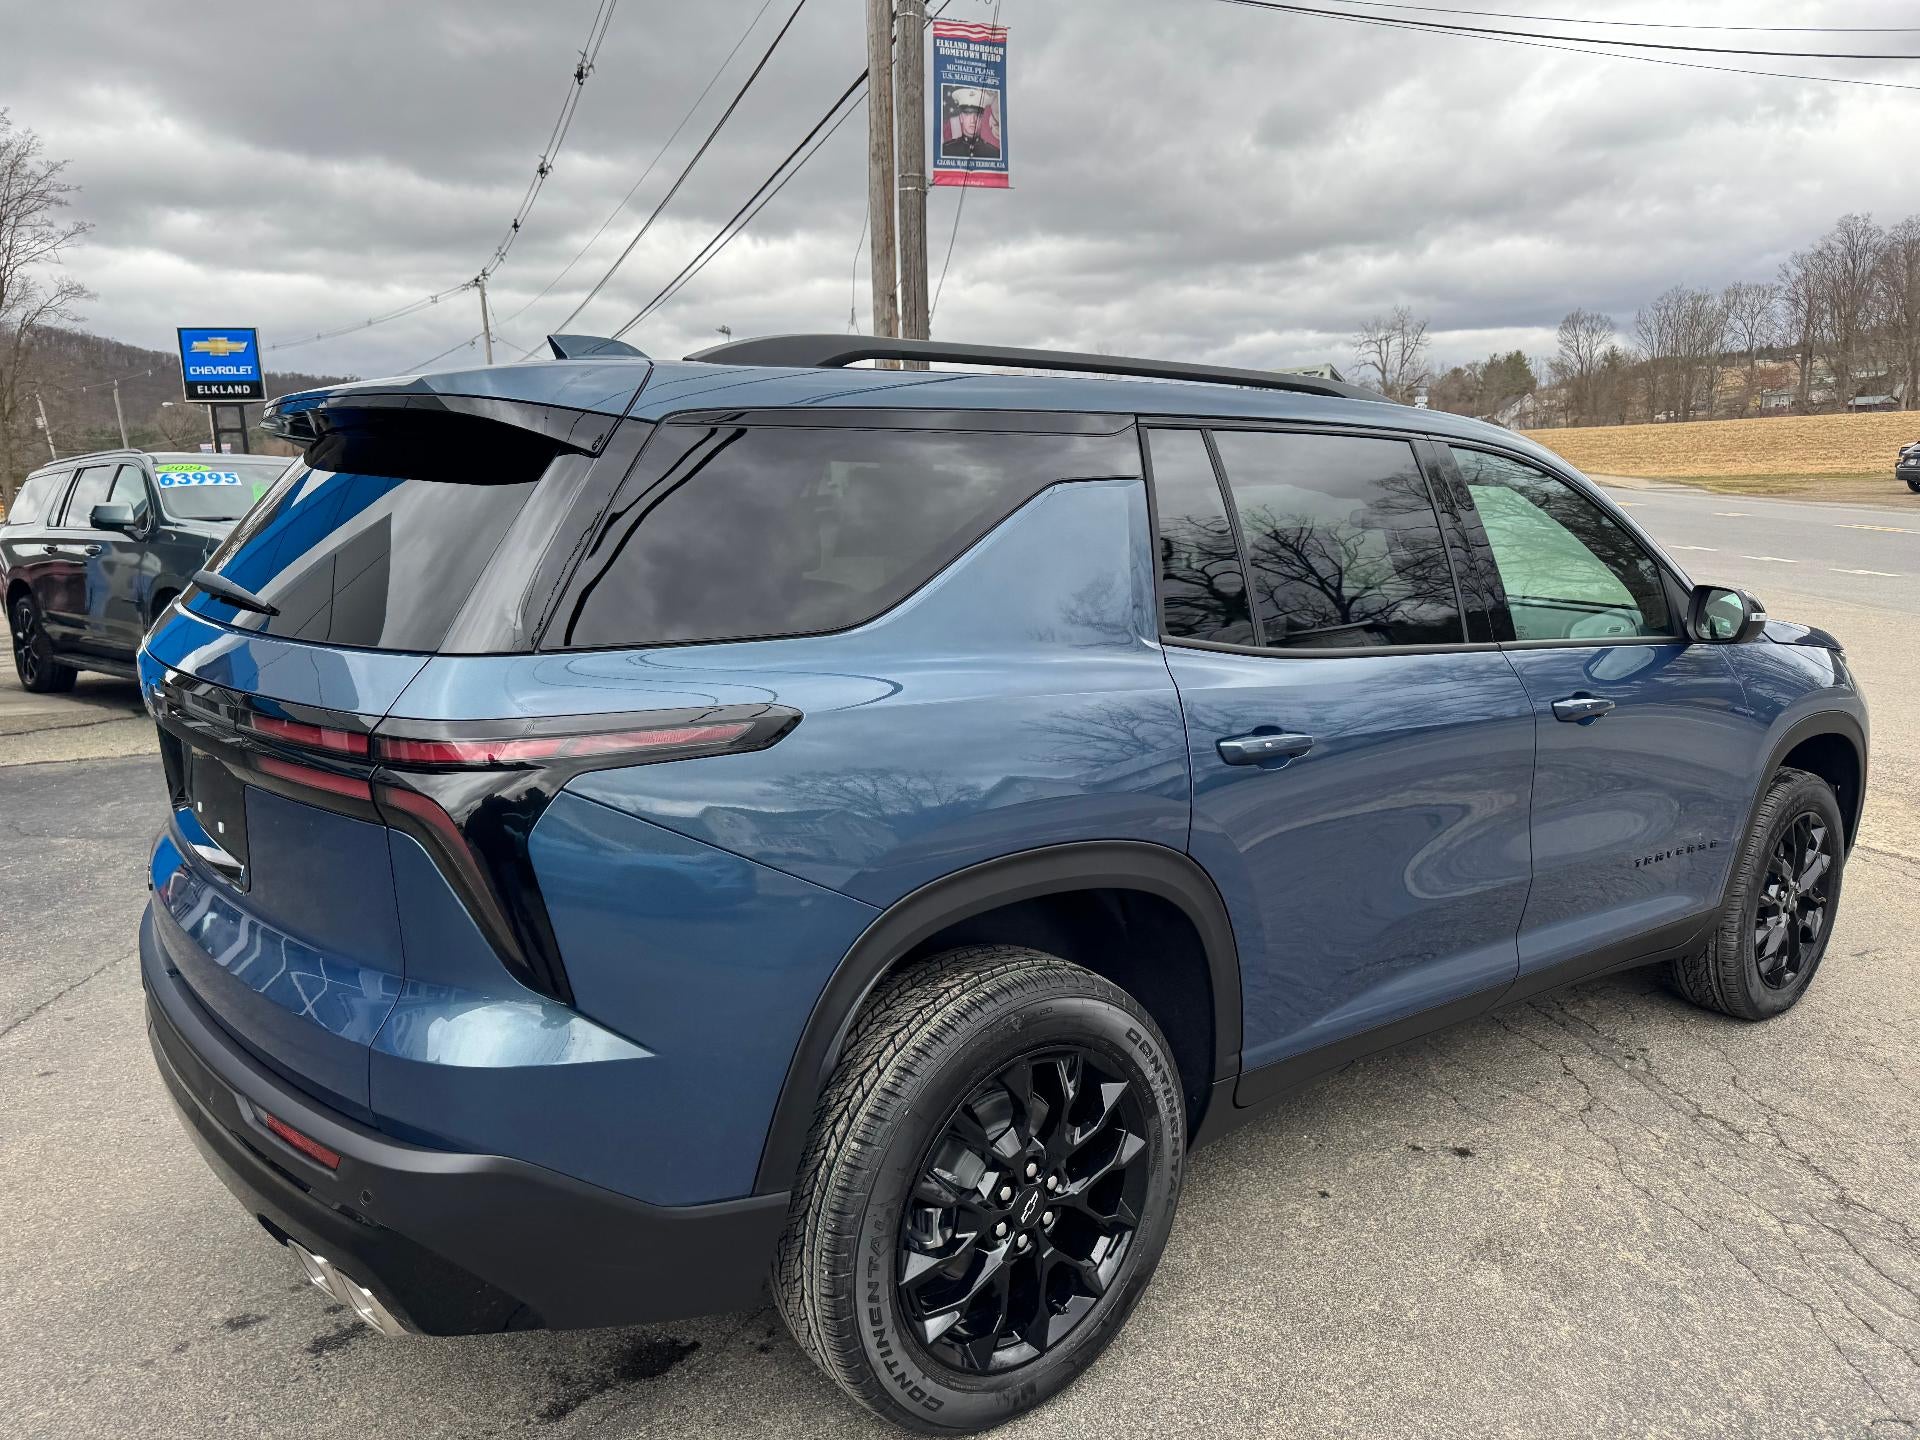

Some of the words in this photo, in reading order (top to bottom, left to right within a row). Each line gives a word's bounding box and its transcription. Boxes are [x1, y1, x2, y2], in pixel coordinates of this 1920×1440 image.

[936, 39, 968, 50] ELKLAND
[969, 43, 1004, 55] BOROUGH
[939, 47, 980, 59] HOMETOWN
[946, 63, 974, 73] MICHAEL
[954, 73, 978, 83] MARINE
[189, 366, 253, 375] CHEVROLET
[197, 385, 251, 394] ELKLAND
[160, 472, 237, 486] 63995
[1634, 839, 1718, 868] TRAVERSE
[867, 1219, 945, 1413] CONTINENTAL
